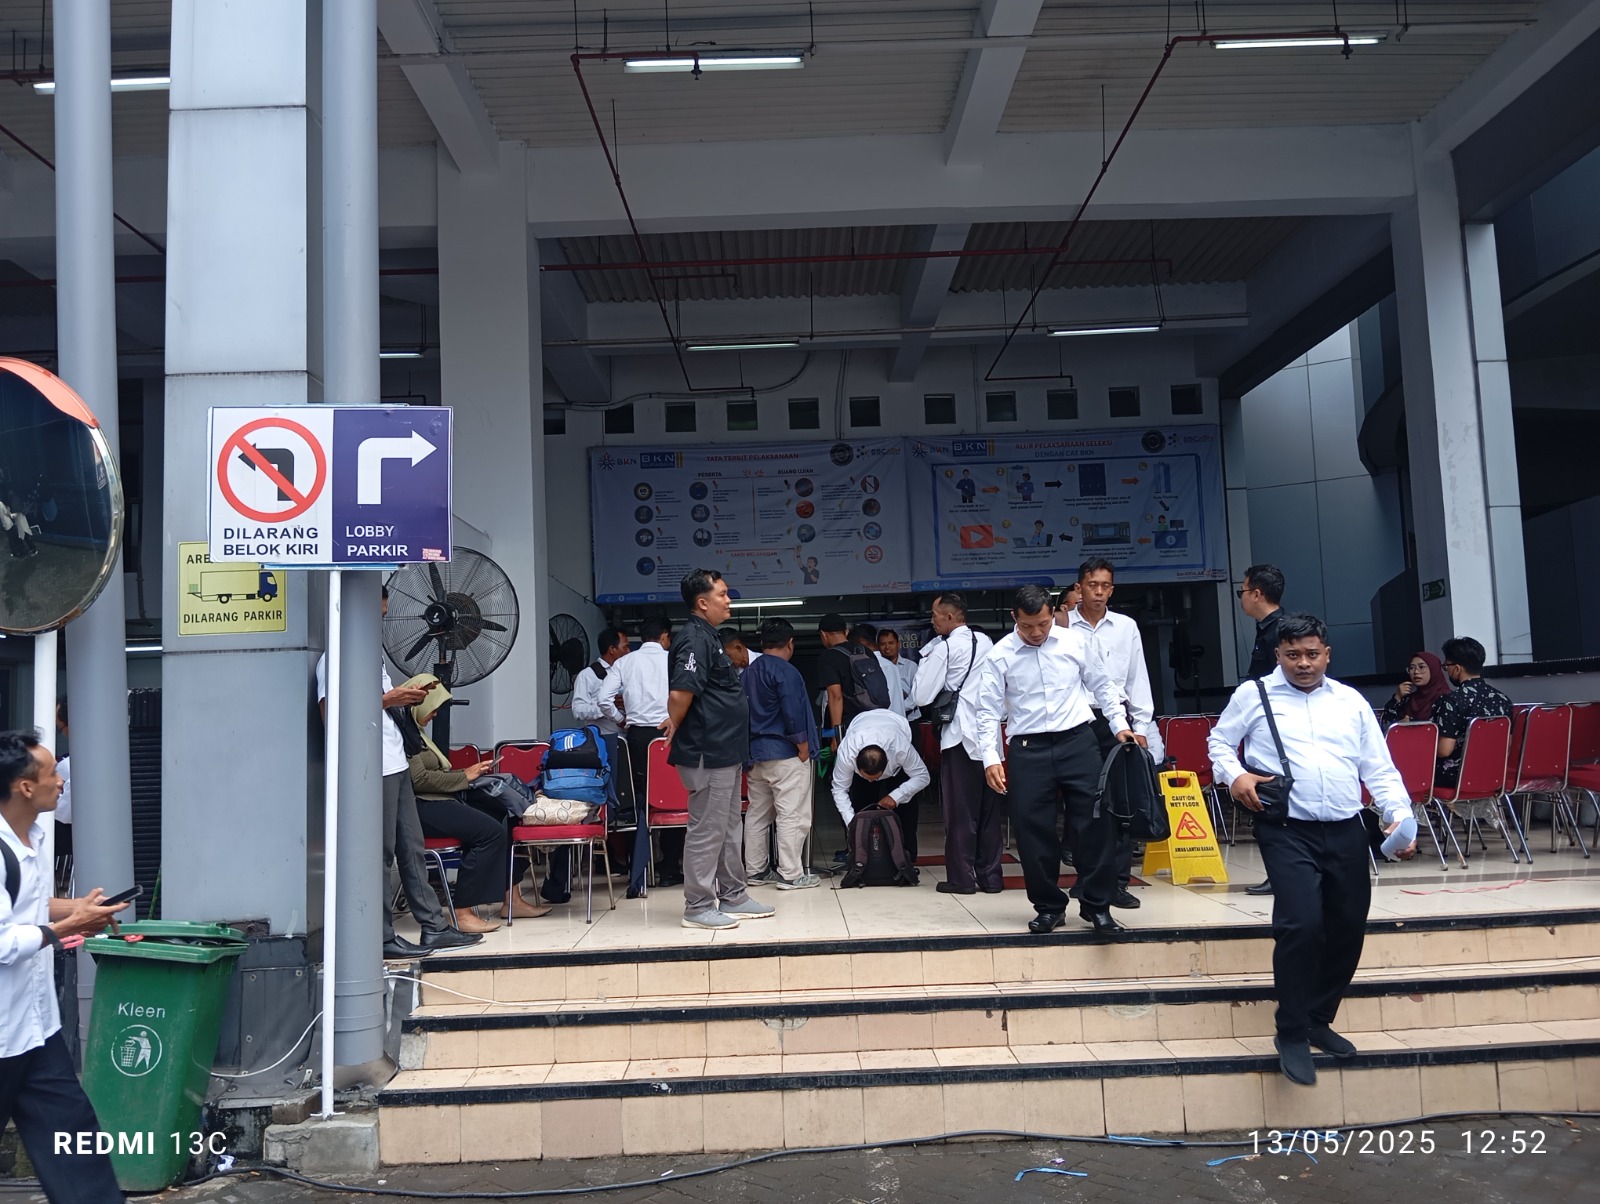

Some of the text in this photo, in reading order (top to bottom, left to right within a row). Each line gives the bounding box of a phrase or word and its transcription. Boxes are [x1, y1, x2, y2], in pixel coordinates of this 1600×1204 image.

[642, 454, 674, 462] BKN
[223, 527, 319, 539] DILARANG
[346, 526, 395, 538] LOBBY
[223, 543, 319, 556] BELOK KIRI
[347, 544, 408, 557] PARKIR
[187, 554, 213, 564] ARE
[183, 610, 283, 624] DILARANG PARKIR
[118, 1002, 166, 1018] Kleen
